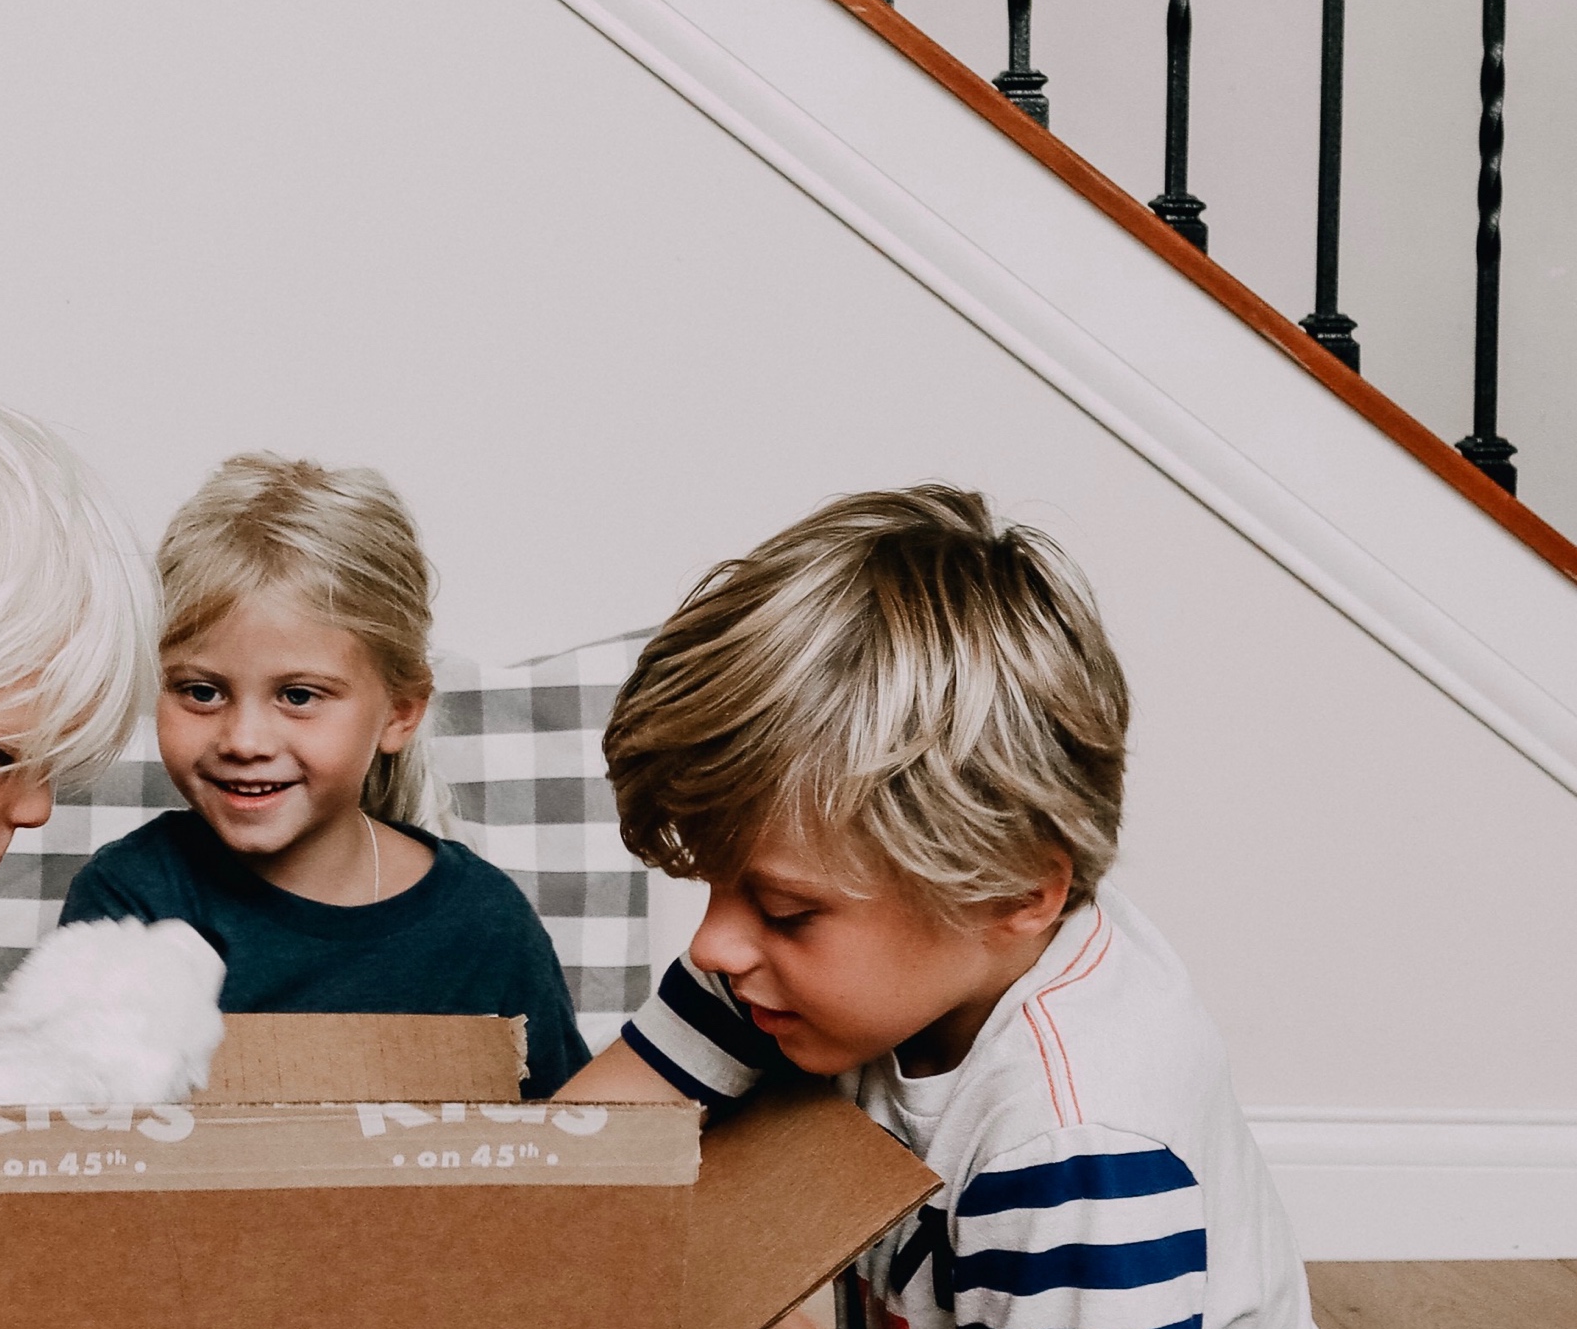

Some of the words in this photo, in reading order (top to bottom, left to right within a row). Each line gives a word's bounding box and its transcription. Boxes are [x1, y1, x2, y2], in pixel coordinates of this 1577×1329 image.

[3, 1157, 48, 1177] on
[57, 1148, 127, 1176] 45th
[417, 1149, 460, 1168] on
[470, 1142, 540, 1168] 45th
